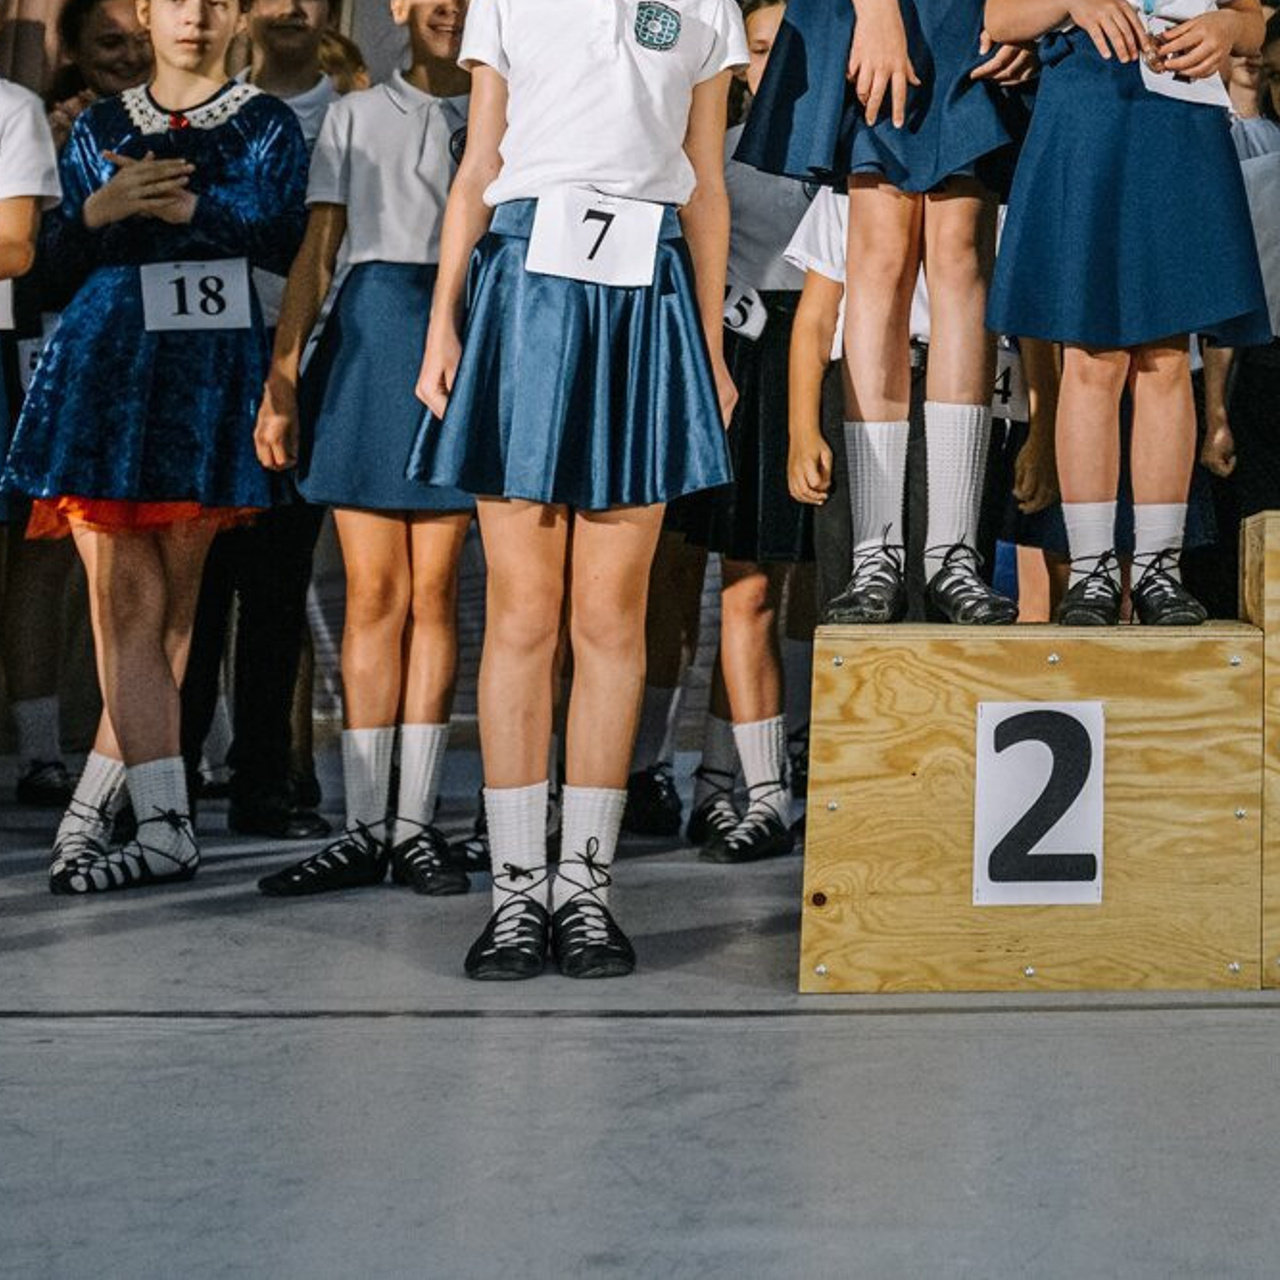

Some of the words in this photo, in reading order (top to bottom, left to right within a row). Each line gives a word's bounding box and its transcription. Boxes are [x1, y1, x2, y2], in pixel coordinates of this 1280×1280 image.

[582, 208, 616, 261] 7
[169, 276, 226, 315] 18
[988, 709, 1098, 883] 2
